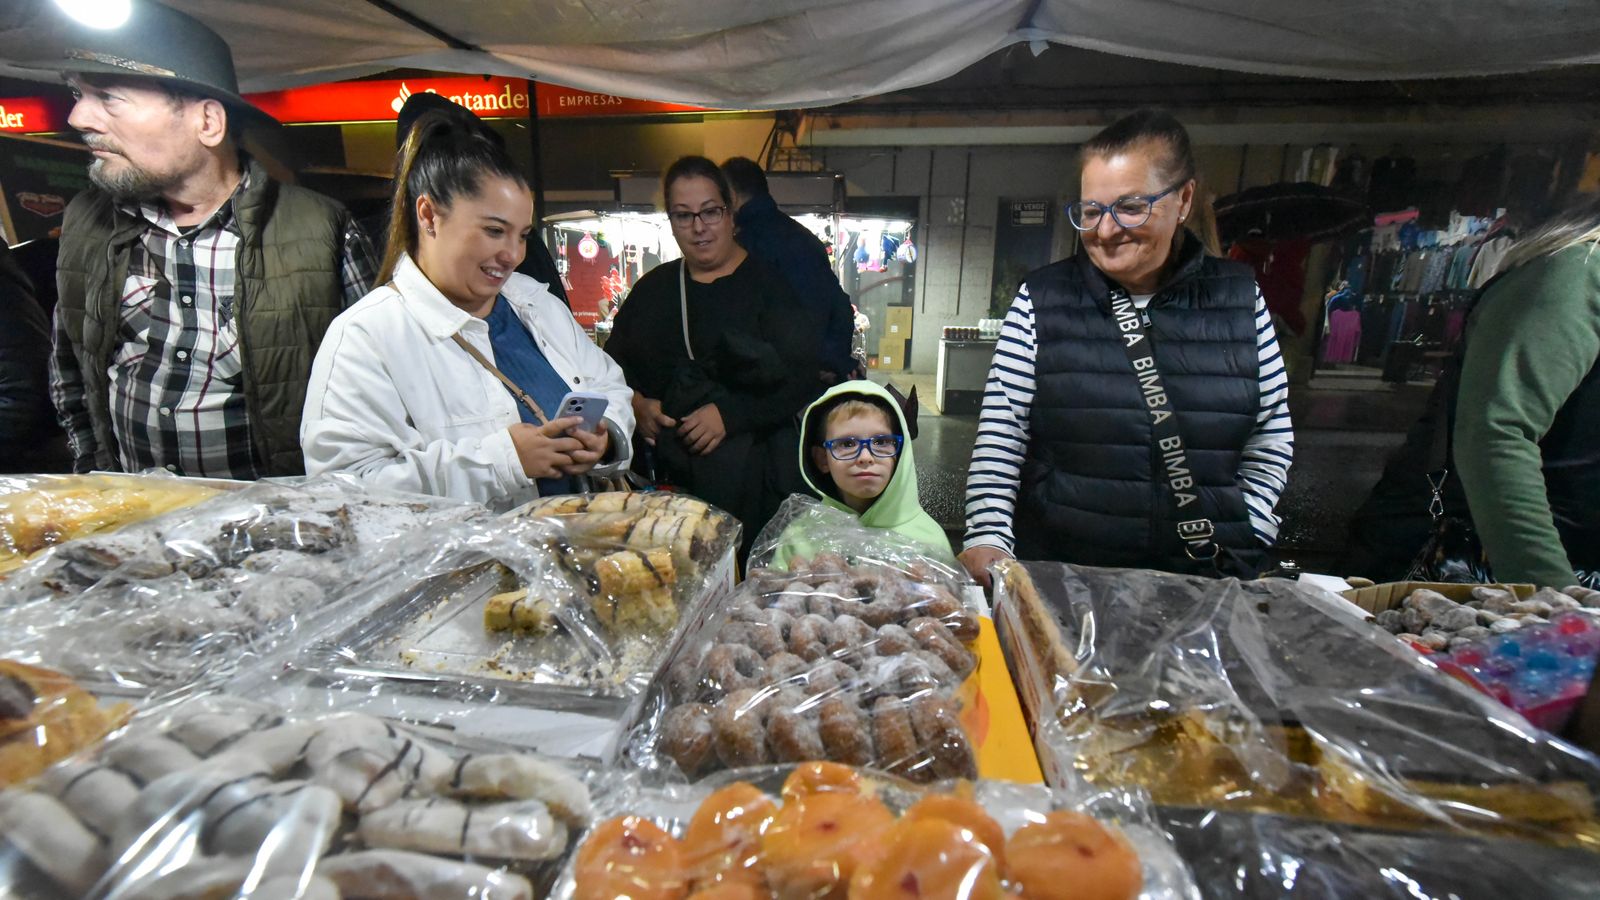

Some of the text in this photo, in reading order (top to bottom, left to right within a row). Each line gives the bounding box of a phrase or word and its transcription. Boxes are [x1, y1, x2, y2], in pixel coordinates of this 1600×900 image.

[559, 95, 623, 106] EMPRESAS
[1133, 356, 1172, 425] BIMBA
[1159, 435, 1198, 508] BIMBA
